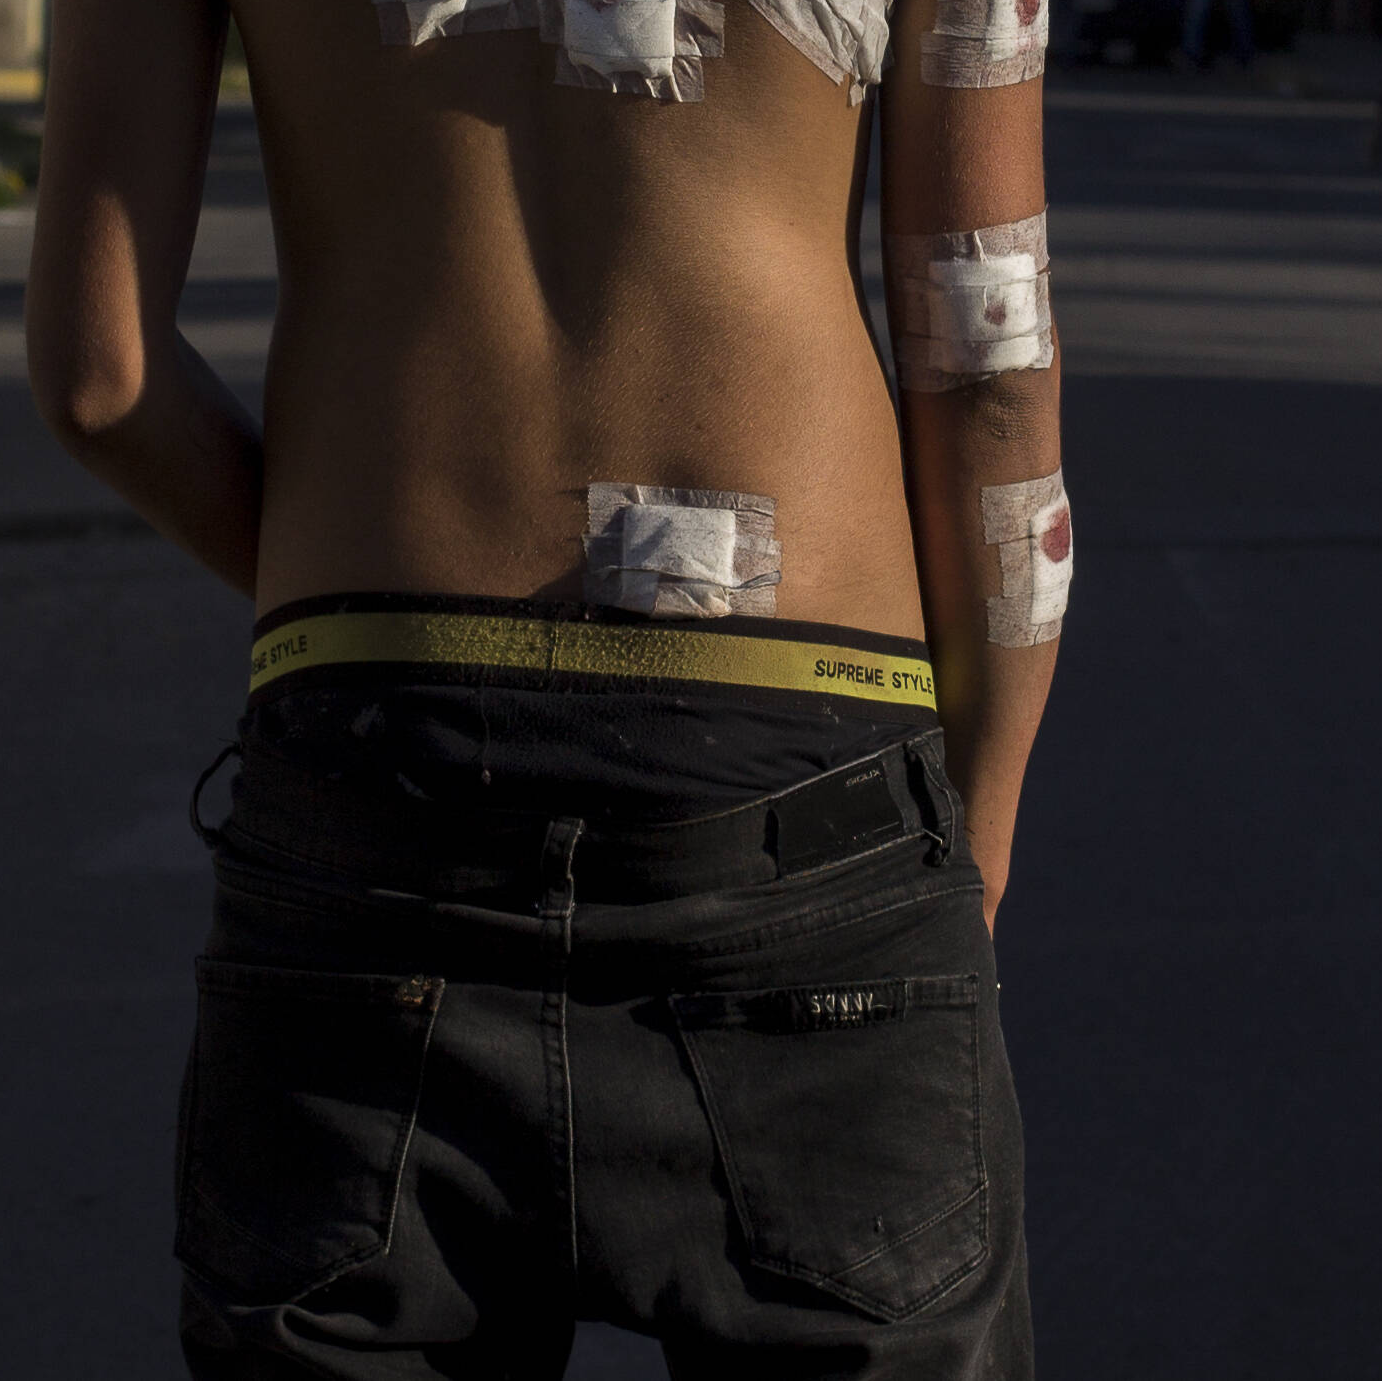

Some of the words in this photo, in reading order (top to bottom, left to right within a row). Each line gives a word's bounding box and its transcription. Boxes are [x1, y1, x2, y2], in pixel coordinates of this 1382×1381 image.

[270, 634, 308, 665] STYLE
[814, 658, 885, 687] SUPREME
[891, 671, 933, 695] STYLE
[810, 992, 874, 1014] SKINNY
